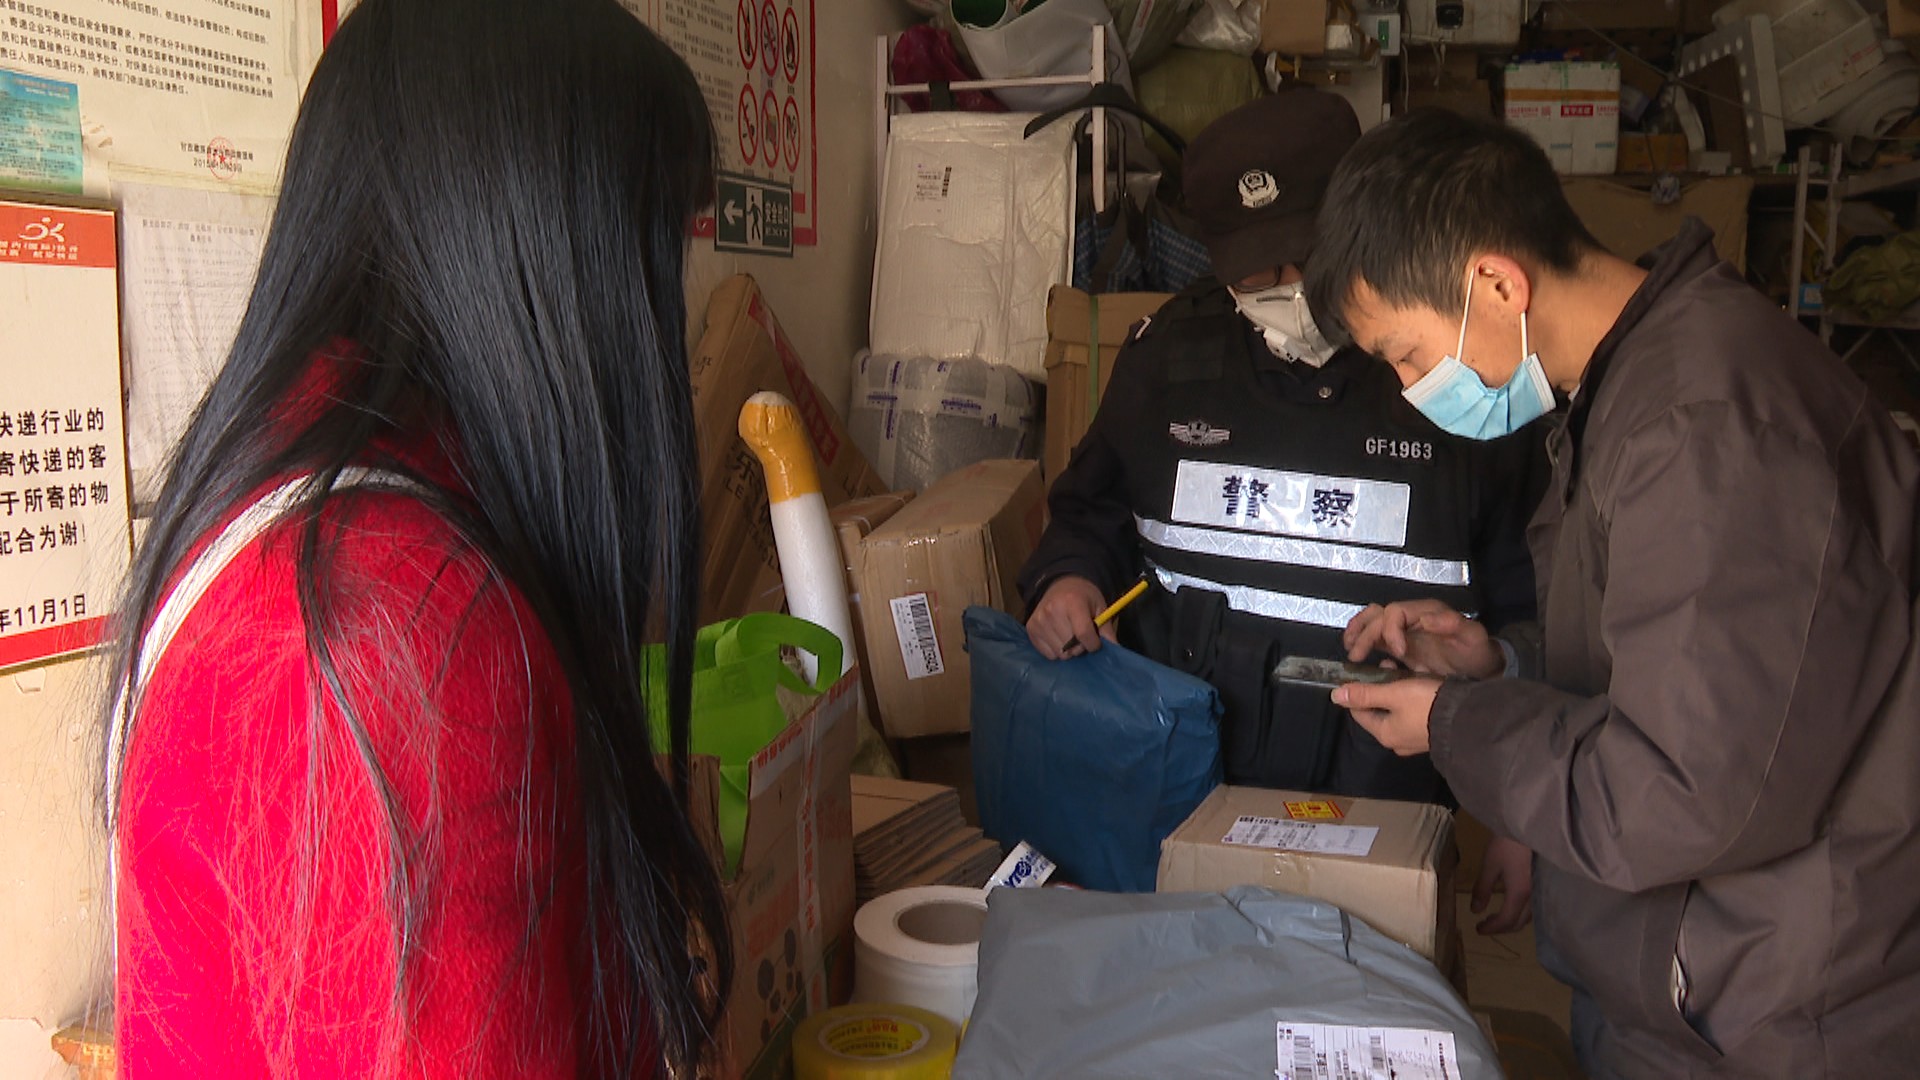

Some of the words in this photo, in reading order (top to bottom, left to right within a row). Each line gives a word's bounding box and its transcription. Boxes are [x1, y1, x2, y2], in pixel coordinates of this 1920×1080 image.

[765, 200, 789, 225] 安全出口
[766, 226, 789, 239] EXIT
[0, 443, 107, 477] 寄快递的客
[1365, 437, 1433, 460] GF1963
[0, 481, 109, 517] 于所寄的物
[1222, 475, 1355, 528] 警察
